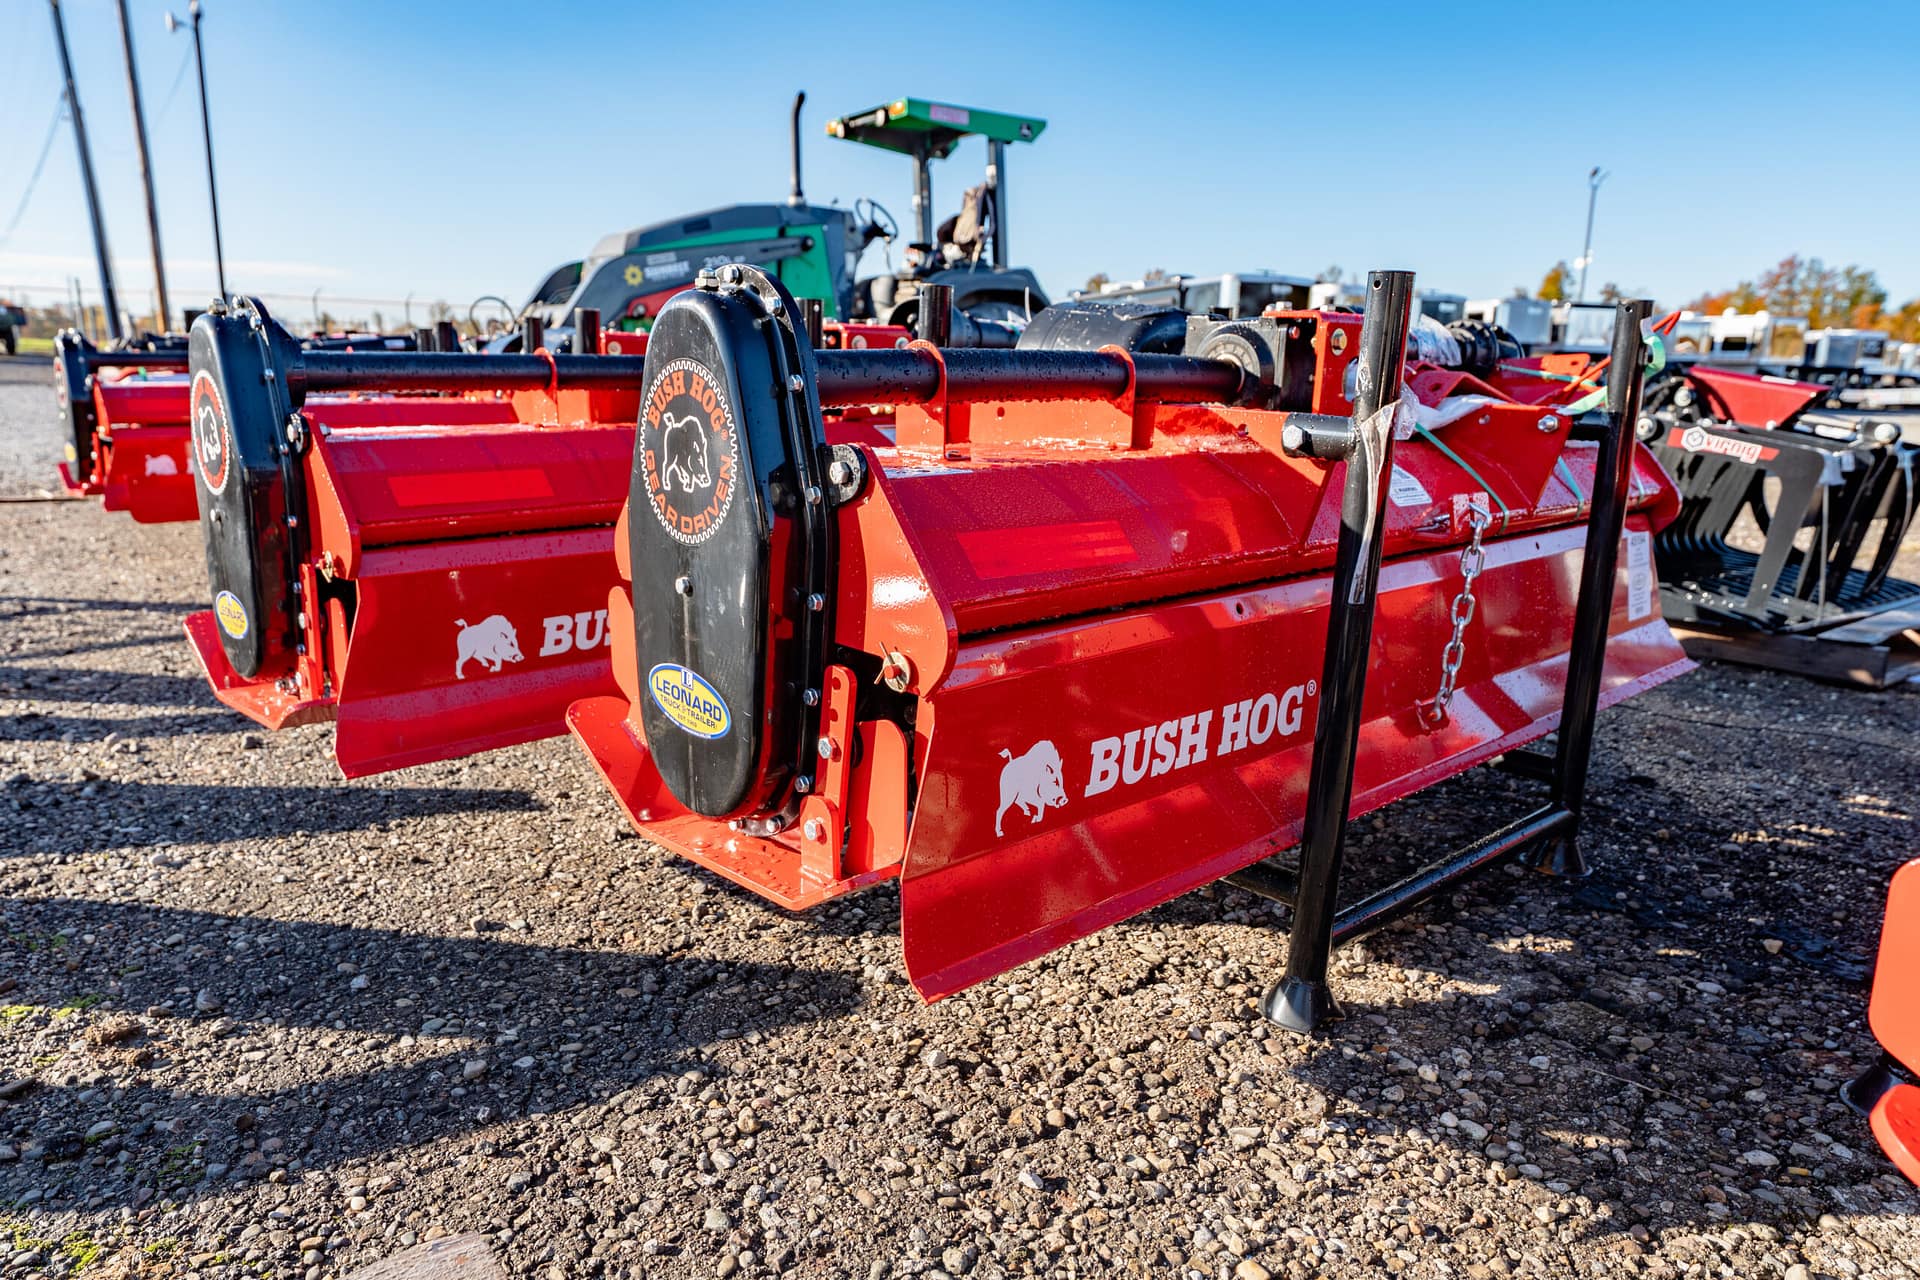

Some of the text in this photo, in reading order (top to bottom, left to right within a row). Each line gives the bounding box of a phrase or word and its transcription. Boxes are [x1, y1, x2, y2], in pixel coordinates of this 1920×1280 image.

[647, 370, 687, 430] BUSH
[644, 449, 733, 534] GEAR DRIVEN
[539, 609, 611, 657] BU
[655, 675, 722, 722] LEONARD
[660, 694, 681, 711] TRUCK
[687, 709, 716, 729] TRAILER
[1084, 709, 1213, 798] BUSH
